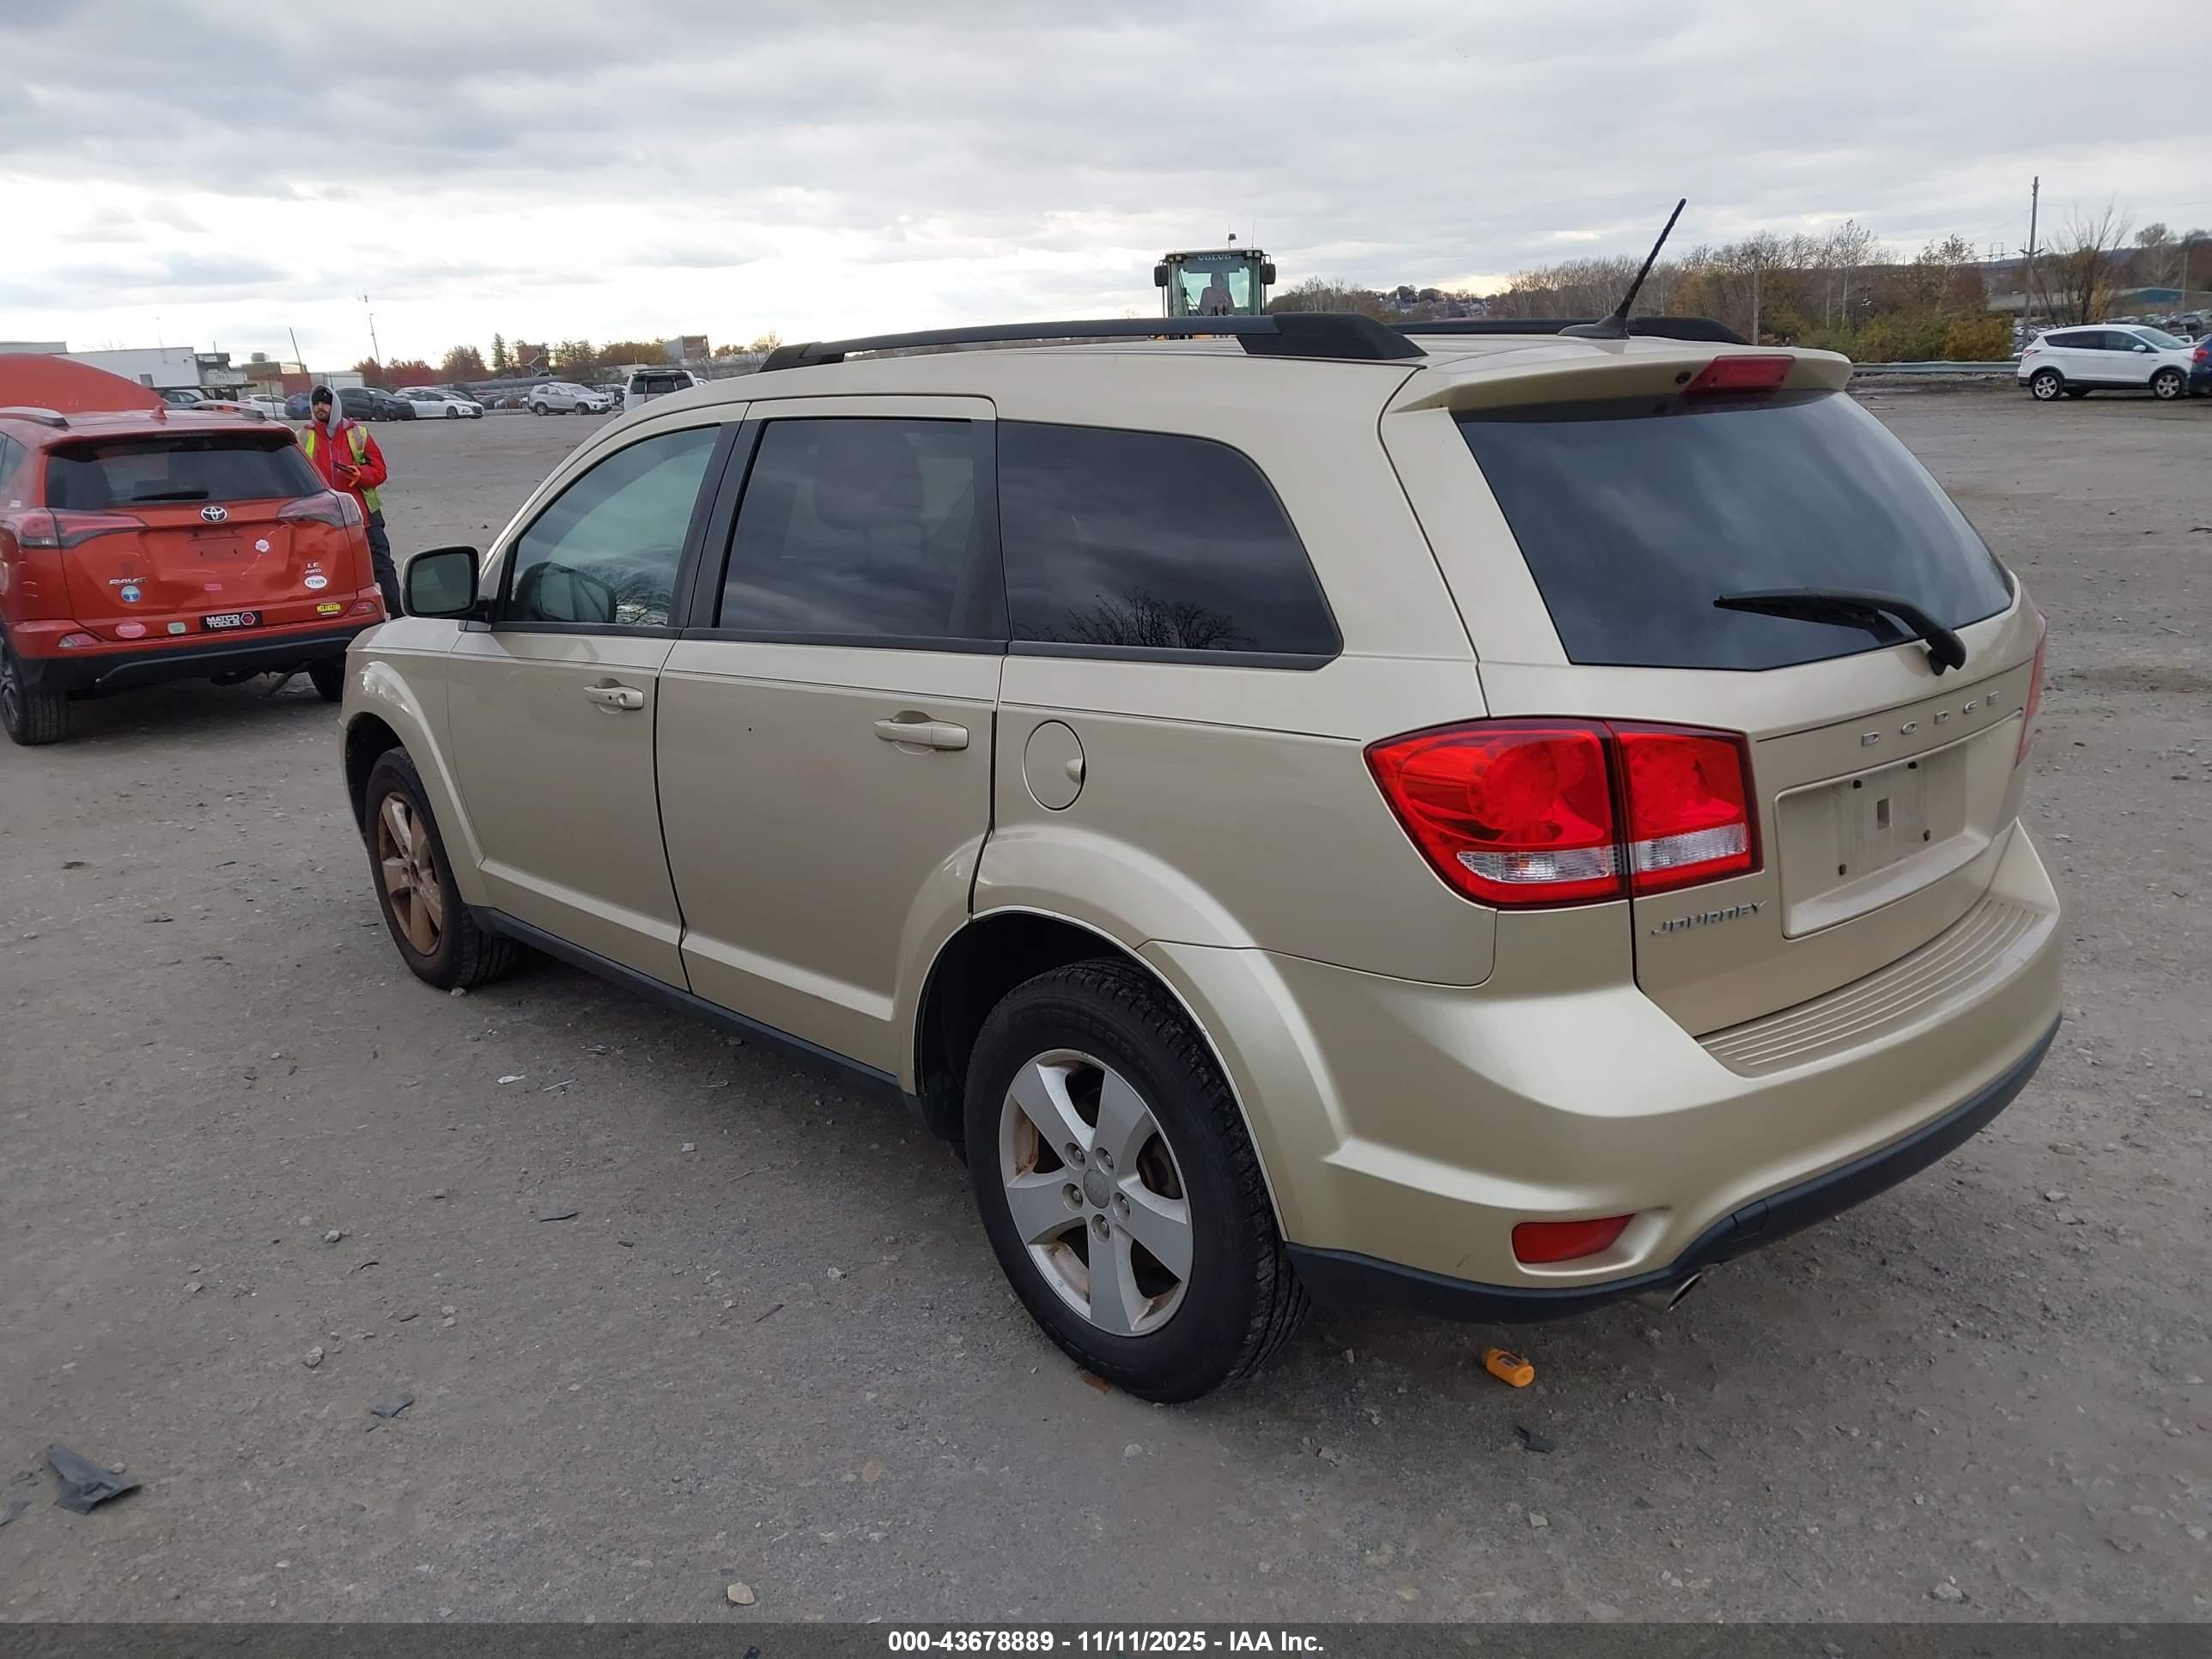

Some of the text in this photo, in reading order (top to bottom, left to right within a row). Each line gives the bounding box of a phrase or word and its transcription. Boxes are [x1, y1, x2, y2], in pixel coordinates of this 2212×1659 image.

[109, 576, 148, 586] RAV4
[206, 614, 240, 624] MATCO
[207, 619, 240, 629] TOOLS
[1861, 690, 2001, 748] DODGE
[1650, 899, 1769, 936] JOURNEY
